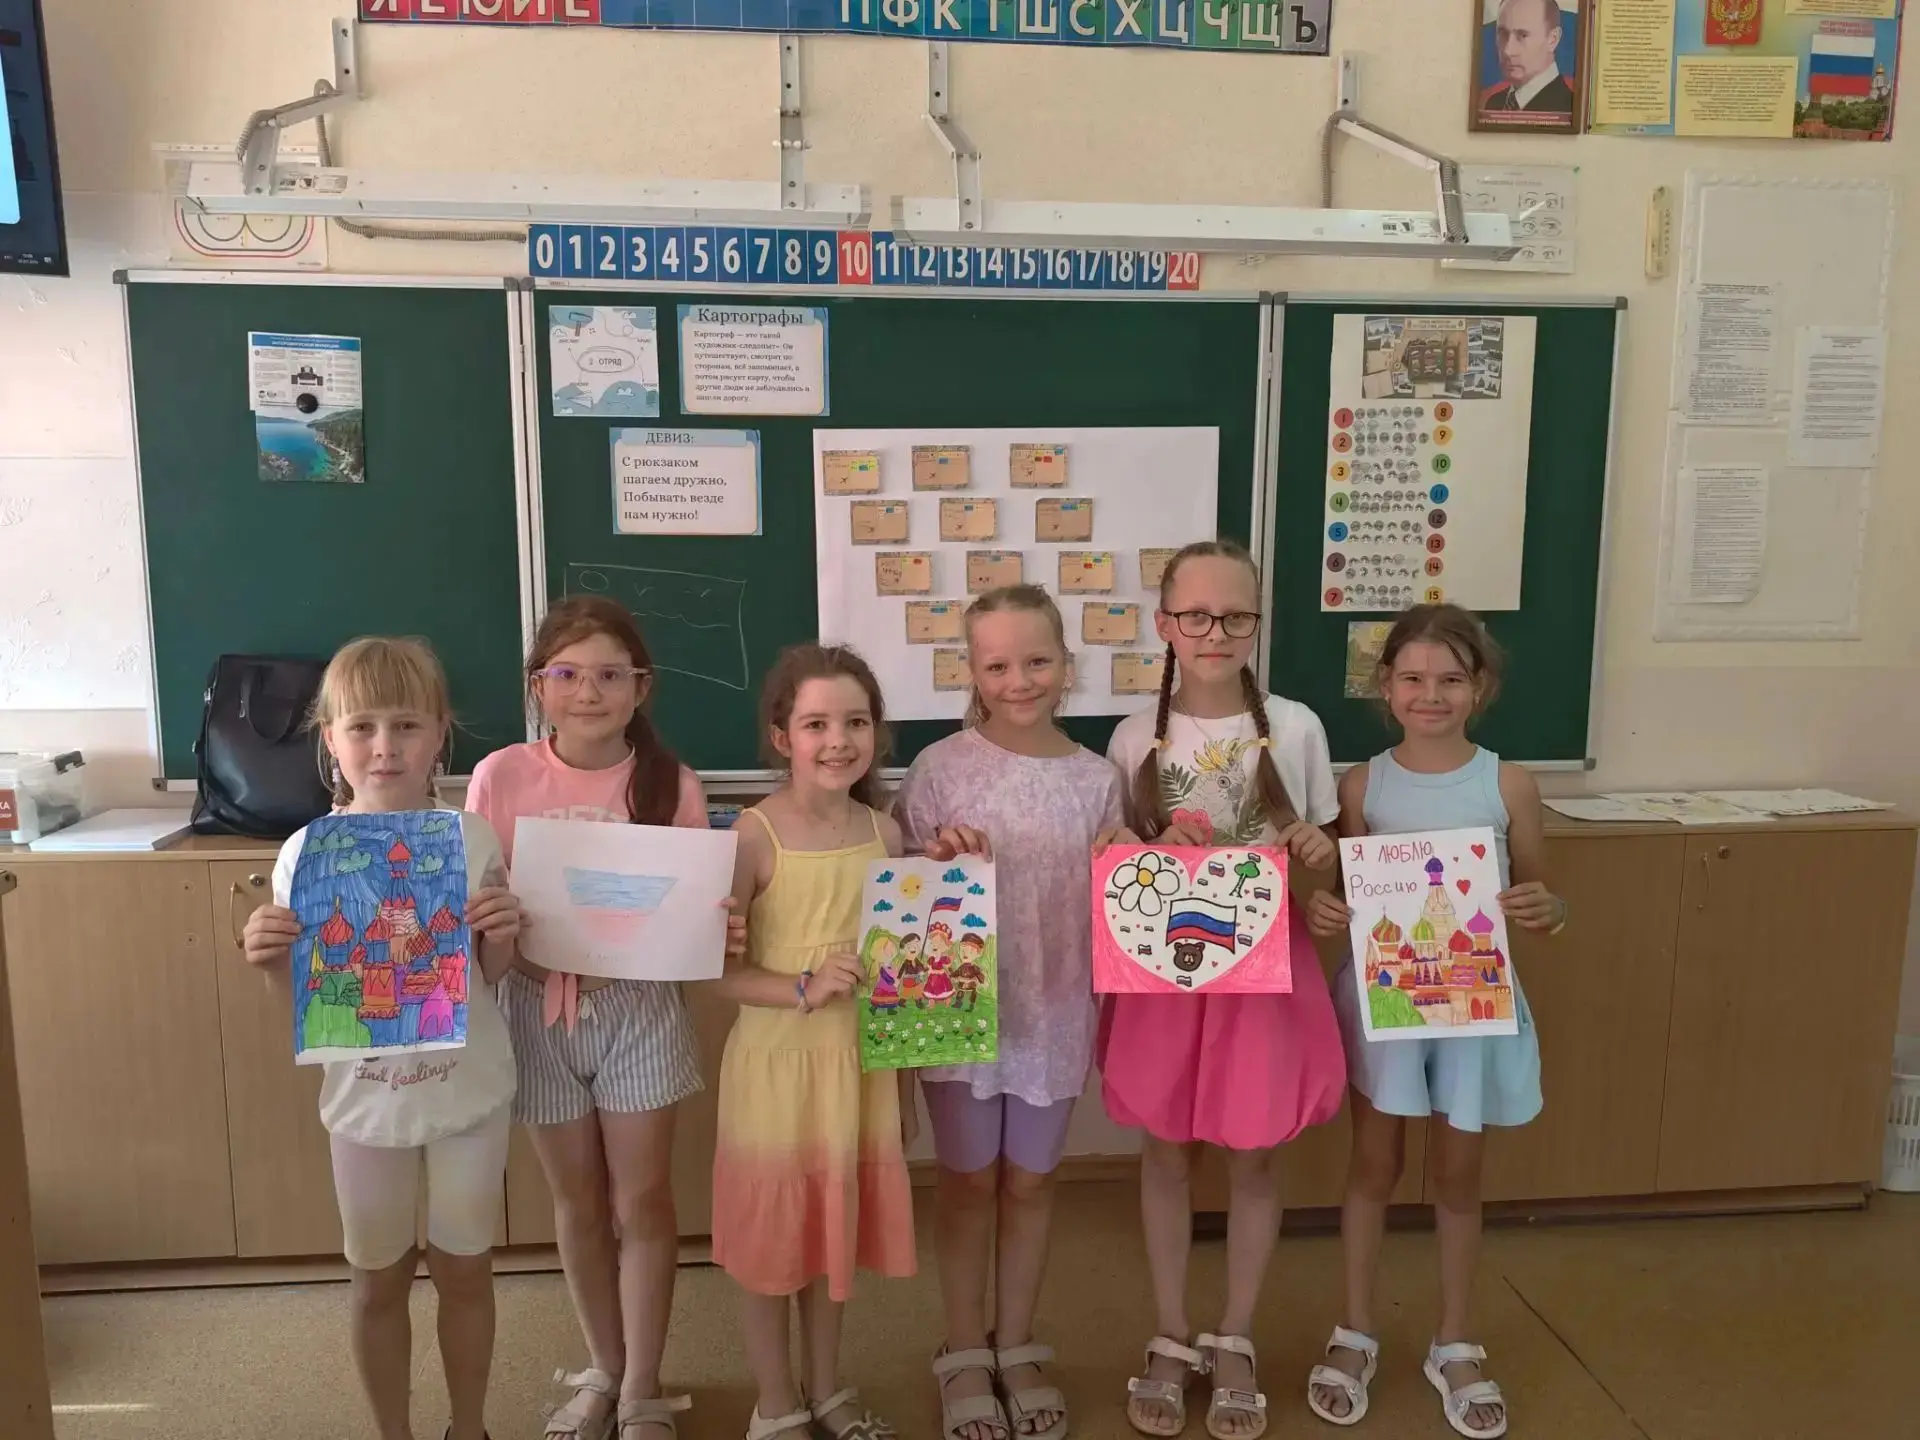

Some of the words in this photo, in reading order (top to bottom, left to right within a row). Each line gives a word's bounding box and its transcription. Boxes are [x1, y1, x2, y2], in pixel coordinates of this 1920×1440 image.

[934, 0, 962, 30] К
[1019, 0, 1057, 34] Ш
[1069, 0, 1096, 36] С
[1113, 0, 1143, 36] Х
[1159, 0, 1189, 44] Ц
[1203, 2, 1229, 40] Ч
[1241, 2, 1281, 47] Щ
[1290, 5, 1318, 43] Ъ
[536, 234, 554, 269] 0
[568, 235, 582, 270] 1
[599, 235, 617, 271] 2
[632, 236, 647, 272] 3
[662, 237, 680, 273] 4
[693, 237, 708, 274] 5
[723, 237, 741, 274] 6
[754, 238, 771, 274] 7
[785, 239, 802, 276] 8
[815, 240, 832, 276] 9
[841, 240, 869, 277] 10
[875, 241, 900, 276] 11
[909, 246, 936, 277] 12
[942, 246, 969, 278] 13
[976, 247, 1004, 279] 14
[1010, 248, 1036, 280] 15
[1043, 249, 1070, 281] 16
[1077, 249, 1101, 281] 17
[1107, 250, 1134, 282] 18
[1139, 250, 1166, 283] 19
[1168, 251, 1199, 283] 20
[697, 308, 803, 327] Картографы
[693, 331, 735, 339] Картограф
[598, 358, 622, 367] ОТРЯД
[772, 374, 796, 382] чтобы
[695, 384, 722, 392] другие
[755, 384, 804, 392] заблудились
[645, 432, 696, 445] ДЕВИЗ:
[622, 456, 631, 467] С
[634, 457, 699, 469] рюкзаком
[623, 475, 670, 485] шагаем
[673, 476, 727, 488] дружно,
[623, 491, 687, 503] Побывать
[690, 494, 724, 504] везде
[1435, 489, 1443, 499] 11
[624, 511, 649, 520] нам
[652, 510, 698, 522] нужно!
[1431, 514, 1443, 523] 12
[1430, 539, 1441, 549] 13
[1429, 562, 1439, 572] 14
[1429, 591, 1439, 600] 15
[1351, 844, 1364, 862] Я
[1378, 841, 1433, 864] ЛЮБЛЮ
[1350, 874, 1417, 899] Россию
[391, 1057, 459, 1091] feelings
